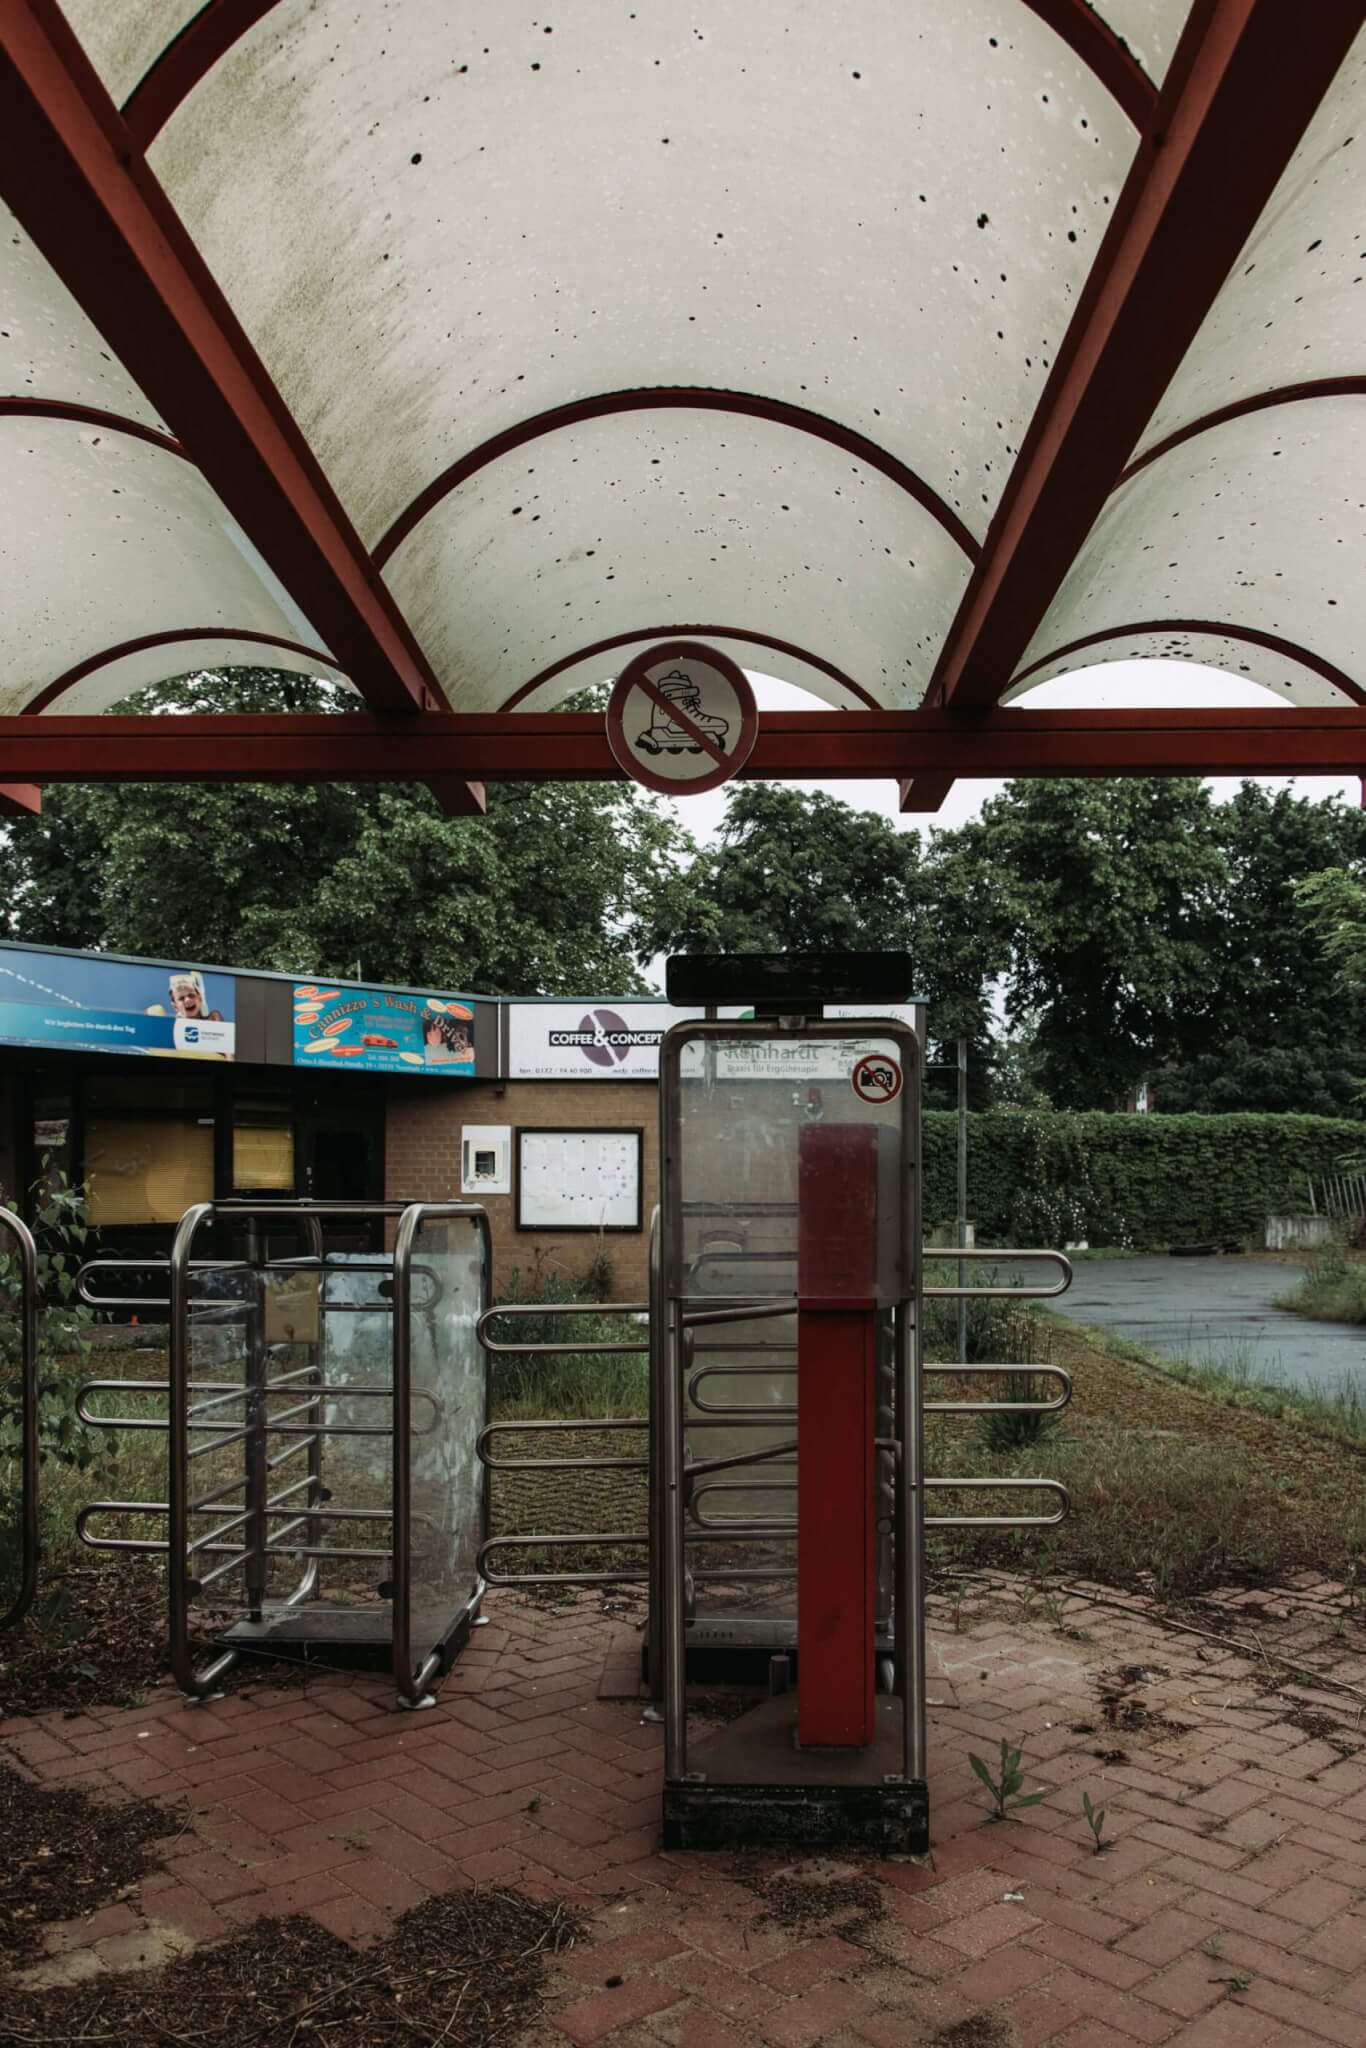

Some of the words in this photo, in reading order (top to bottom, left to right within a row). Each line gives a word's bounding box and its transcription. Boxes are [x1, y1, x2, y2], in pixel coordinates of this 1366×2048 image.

[384, 995, 416, 1013] Wash
[420, 1007, 430, 1019] &
[432, 1015, 468, 1051] Drive
[551, 1033, 593, 1045] COFFEE
[593, 1027, 611, 1047] &
[610, 1033, 662, 1044] CONCEPT
